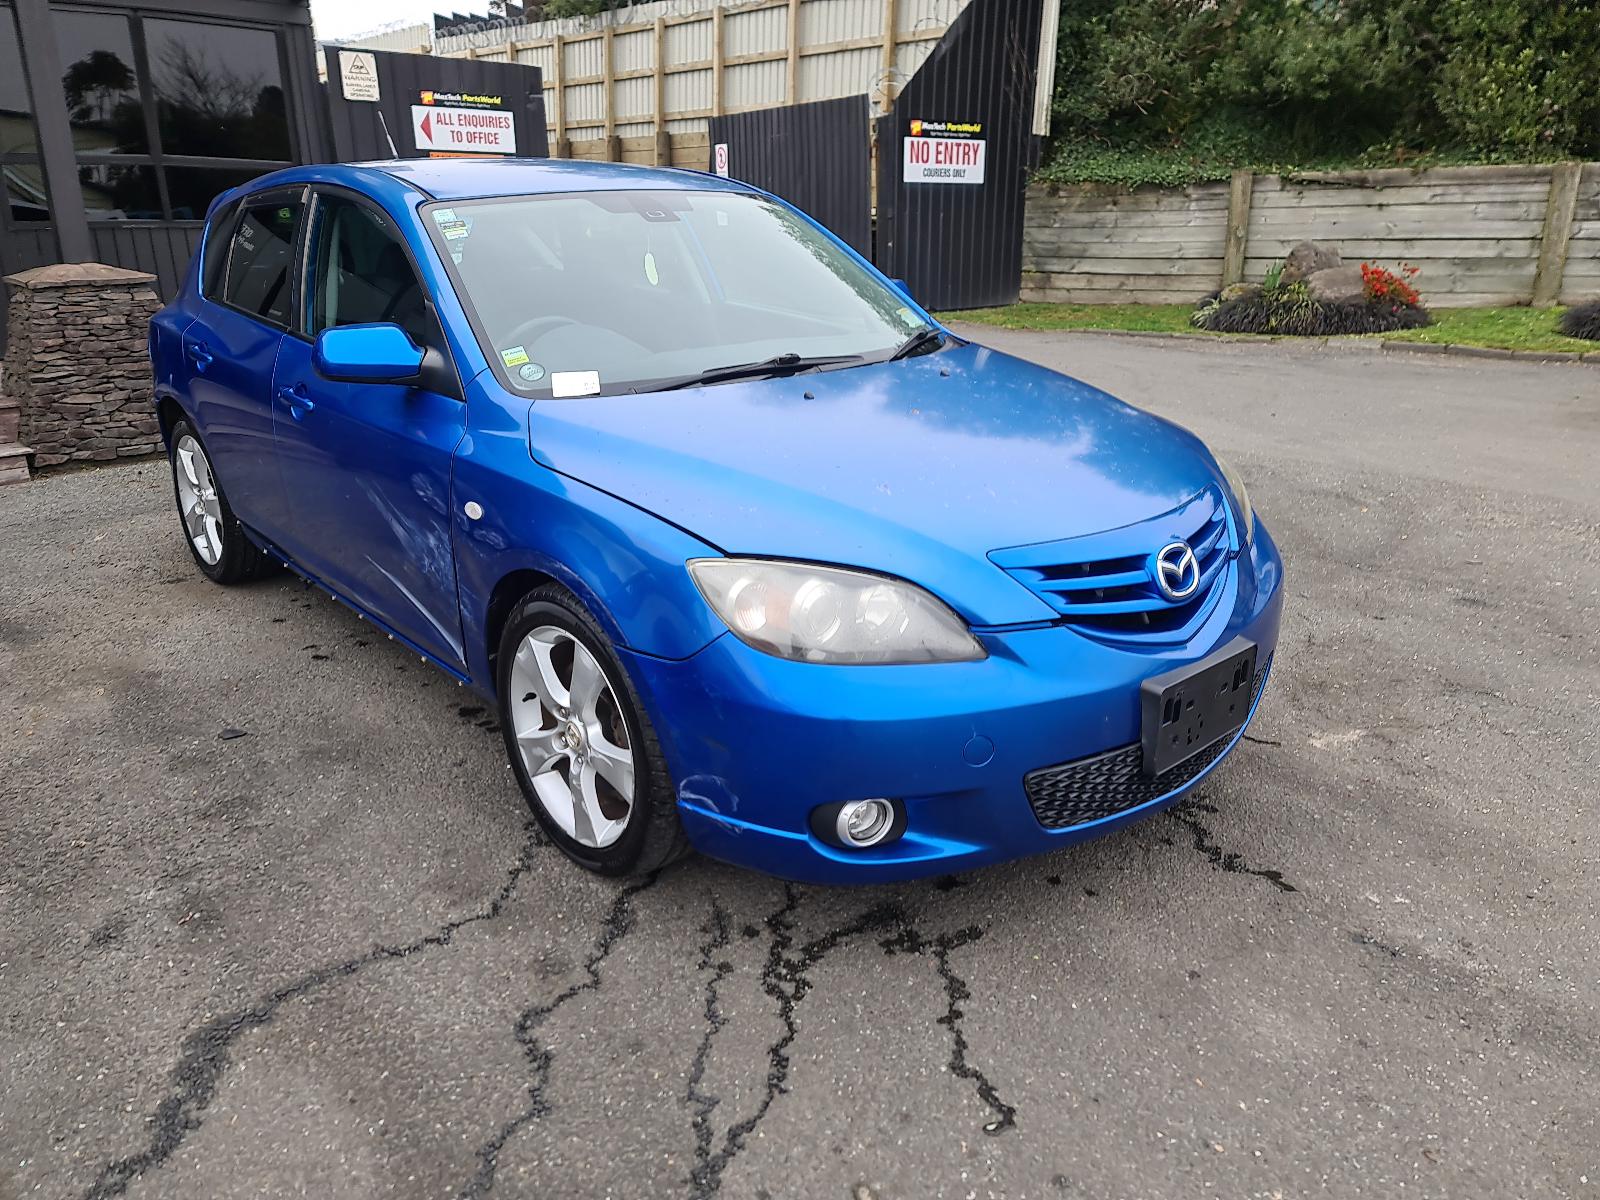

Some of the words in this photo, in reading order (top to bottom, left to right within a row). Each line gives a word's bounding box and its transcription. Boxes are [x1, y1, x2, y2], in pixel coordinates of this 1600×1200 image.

[462, 94, 501, 104] PartsWorld
[436, 112, 455, 126] ALL
[457, 113, 511, 129] ENQUIRIES
[450, 129, 463, 143] TO
[466, 131, 500, 145] OFFICE
[910, 140, 930, 164] NO
[935, 141, 980, 166] ENTRY
[923, 168, 951, 178] COURIERS
[953, 168, 966, 178] ONLY
